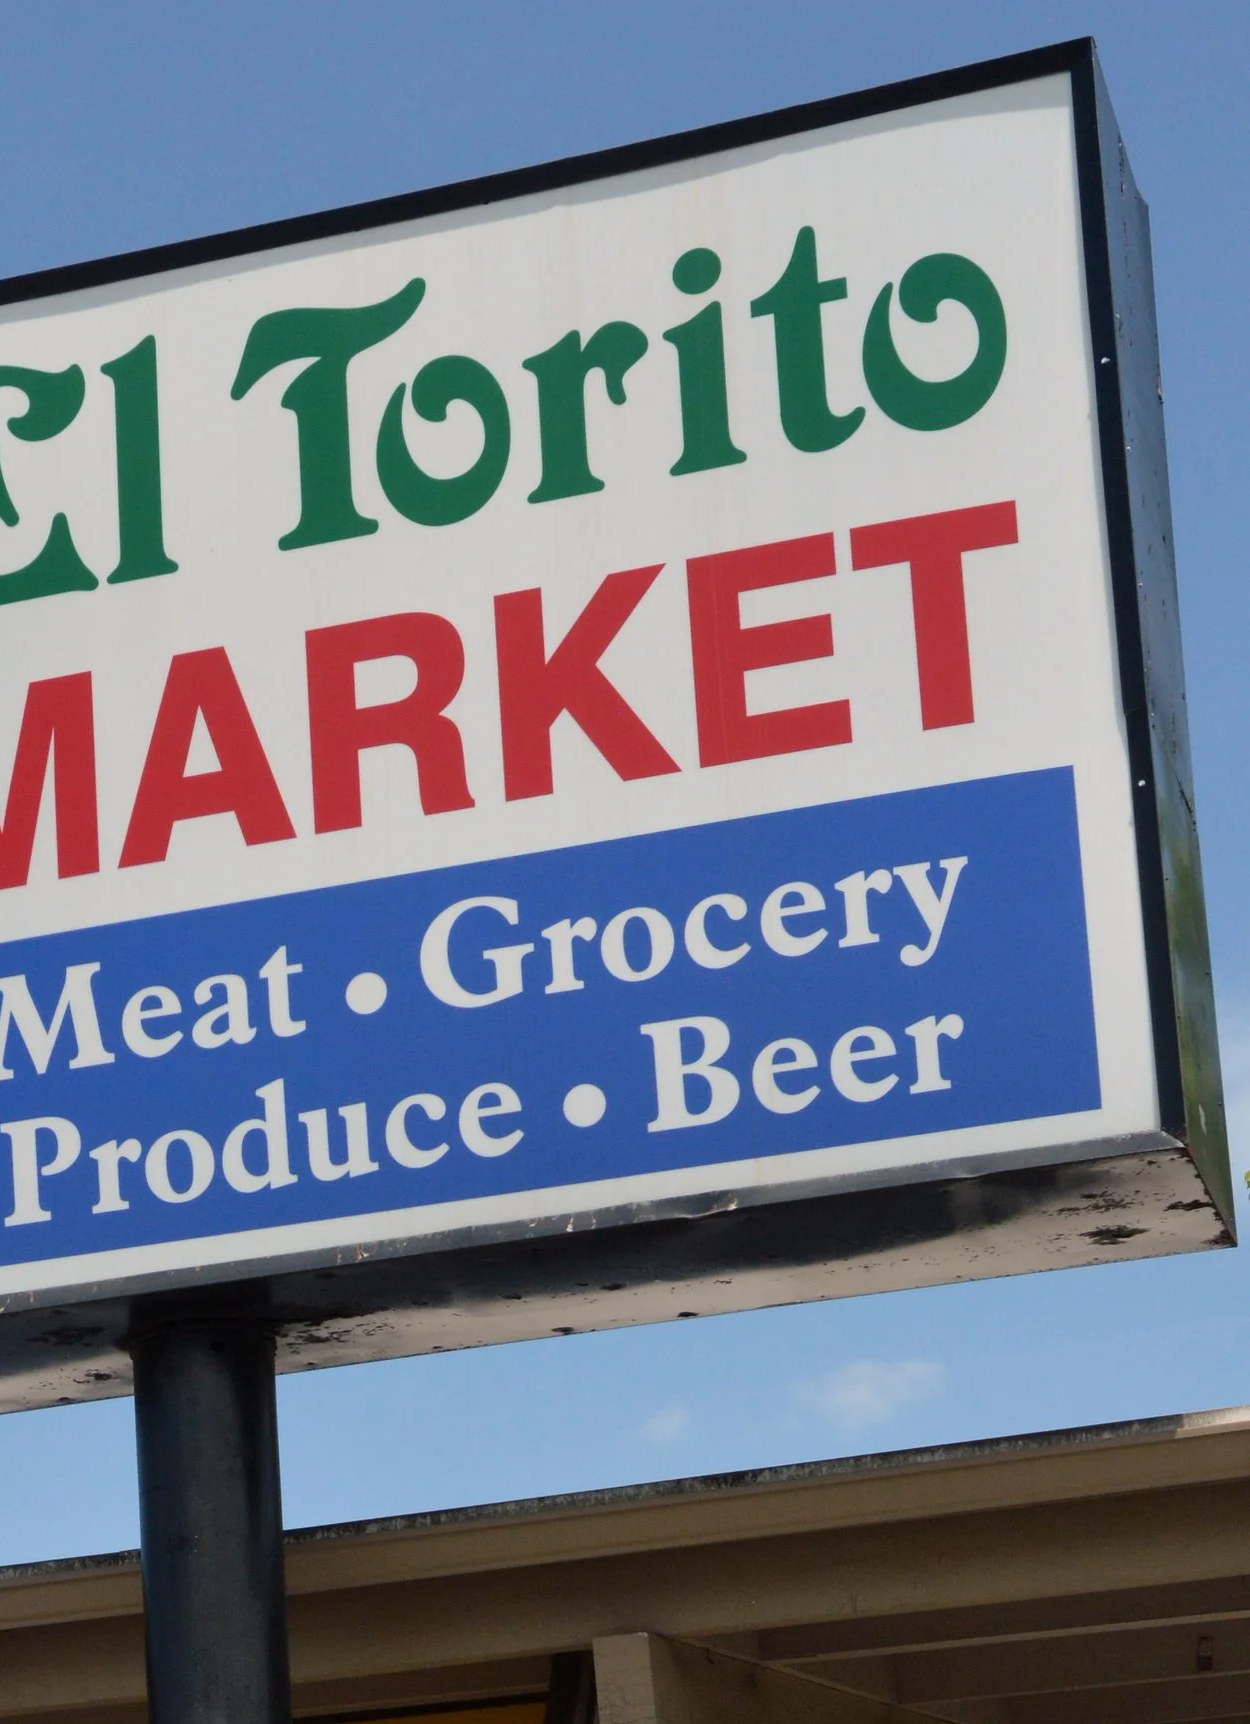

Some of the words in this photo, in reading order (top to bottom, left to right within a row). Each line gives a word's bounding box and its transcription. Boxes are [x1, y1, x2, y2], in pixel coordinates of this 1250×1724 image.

[230, 225, 1008, 551] Torito
[420, 854, 969, 1010] Grocery
[2, 1080, 526, 1228] Produce
[641, 1011, 964, 1134] Beer
